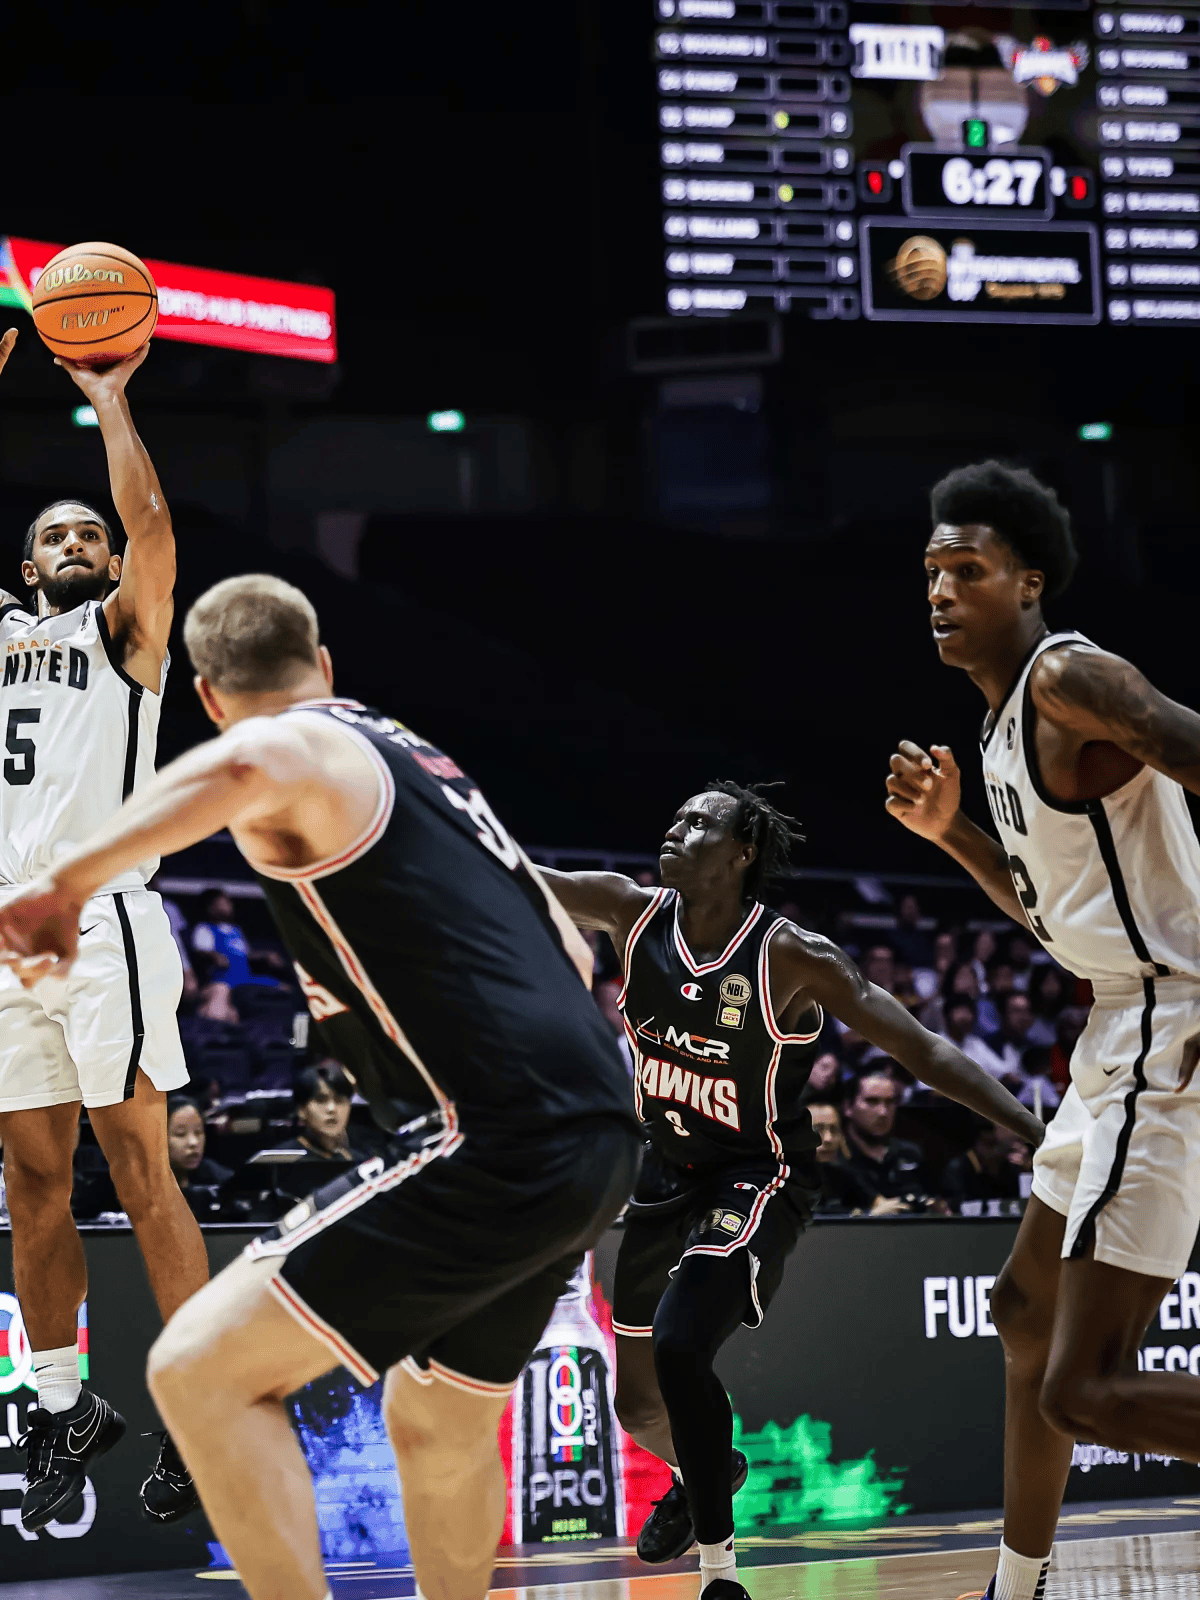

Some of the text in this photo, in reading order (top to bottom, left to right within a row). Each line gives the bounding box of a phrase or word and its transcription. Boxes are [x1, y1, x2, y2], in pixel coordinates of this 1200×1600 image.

[942, 157, 1042, 206] 6:27
[43, 263, 124, 292] Wilson
[3, 707, 42, 786] 5
[726, 982, 745, 998] NBL
[664, 1025, 731, 1060] MCR
[640, 1056, 740, 1132] AWKS
[923, 1274, 1000, 1339] FUE
[529, 1468, 608, 1513] PRO
